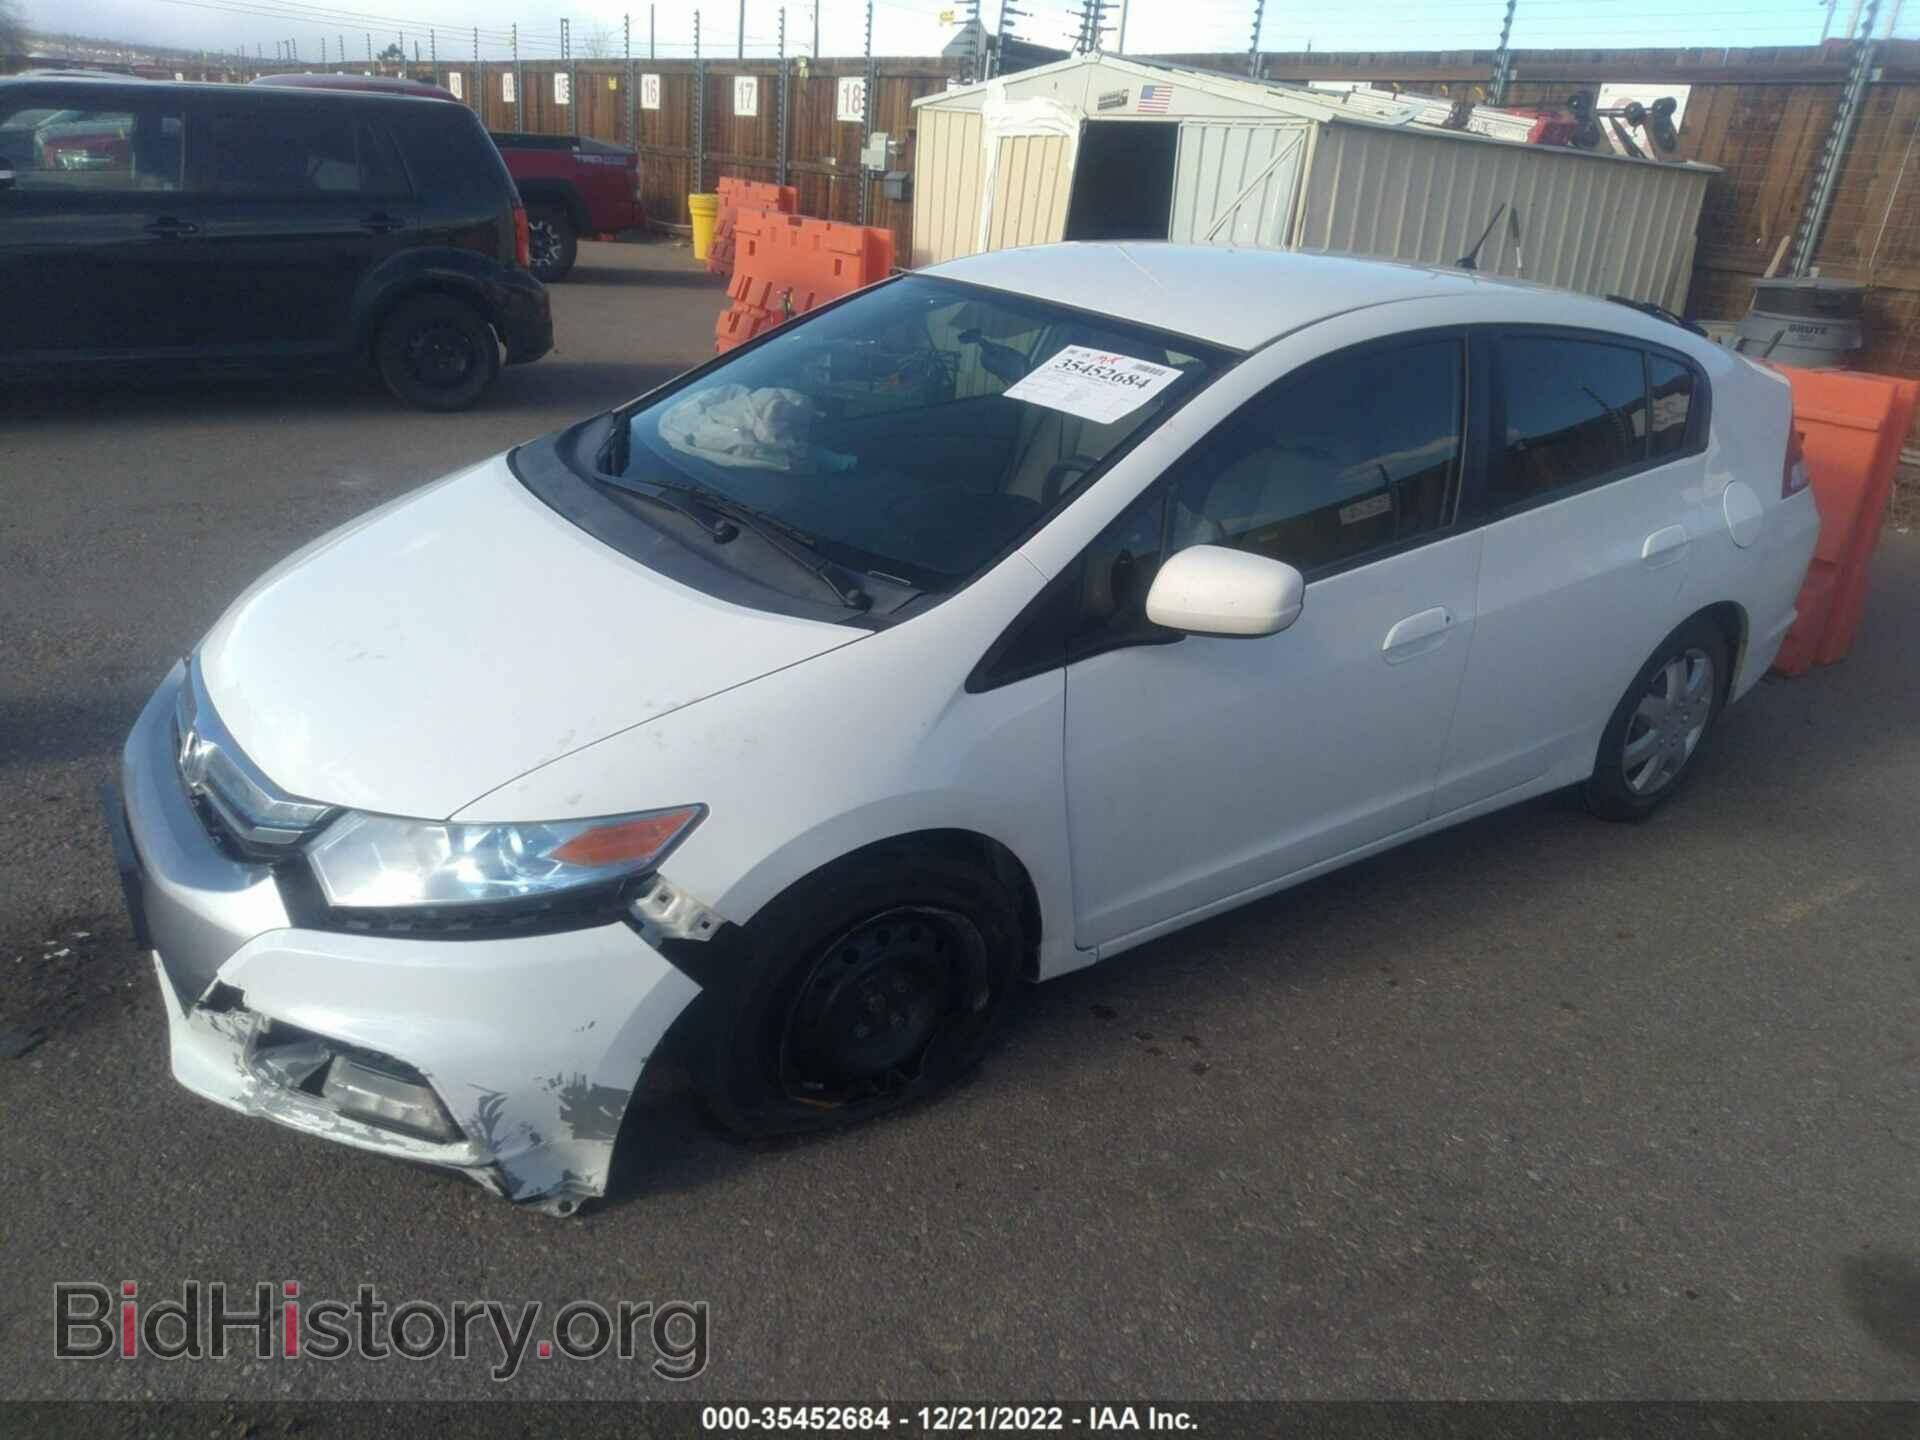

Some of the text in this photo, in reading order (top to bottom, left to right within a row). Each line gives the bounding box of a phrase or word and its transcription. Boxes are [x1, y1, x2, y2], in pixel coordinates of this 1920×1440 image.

[644, 79, 657, 104] 16
[738, 81, 755, 110] 17
[843, 83, 863, 115] 18
[1054, 358, 1152, 389] 35452684
